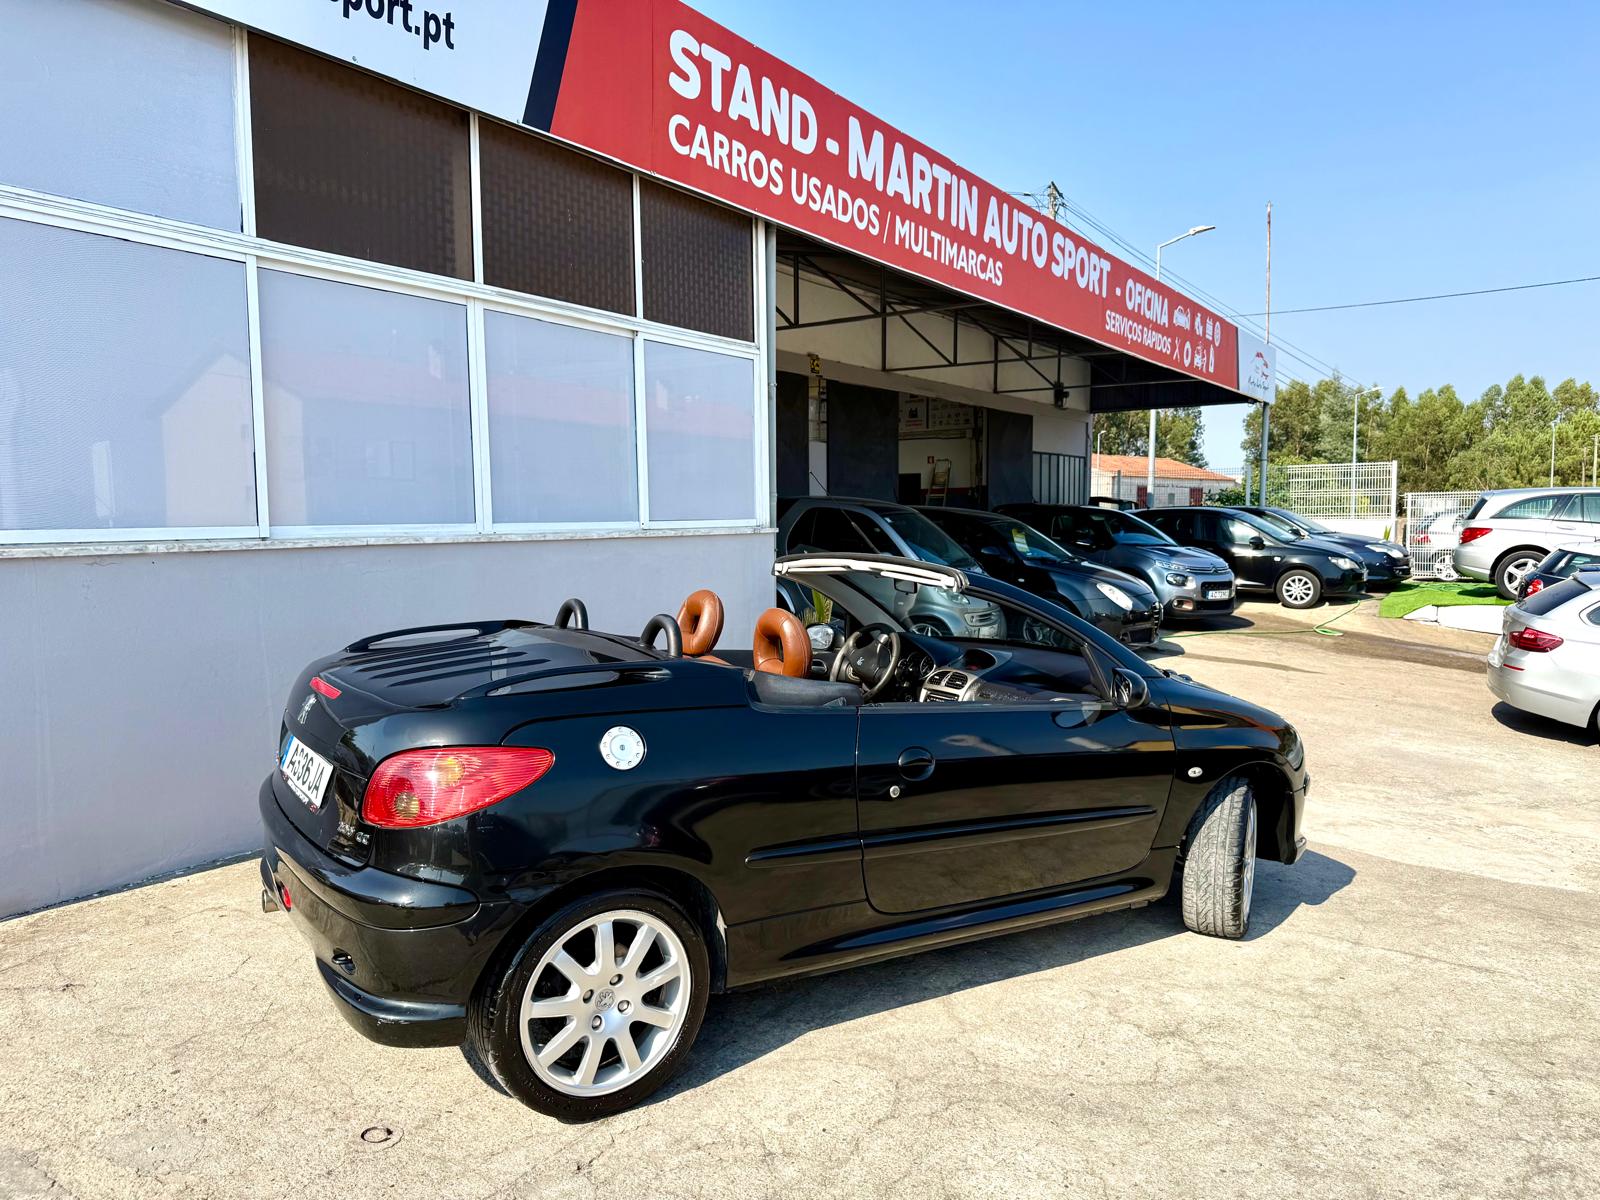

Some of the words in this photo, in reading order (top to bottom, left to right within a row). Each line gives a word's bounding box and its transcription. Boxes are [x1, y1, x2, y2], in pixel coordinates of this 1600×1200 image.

[668, 29, 818, 155] STAND
[847, 115, 979, 237] MARTIN
[983, 195, 1049, 269] AUTO
[1050, 231, 1112, 299] SPORT
[1125, 278, 1169, 329] OFICINA
[668, 113, 784, 196] CARROS
[790, 167, 881, 236] USADOS
[894, 214, 1003, 287] MULTIMARCAS
[1105, 309, 1143, 345] SERVIÇOS
[1143, 323, 1172, 355] RÁPIDOS
